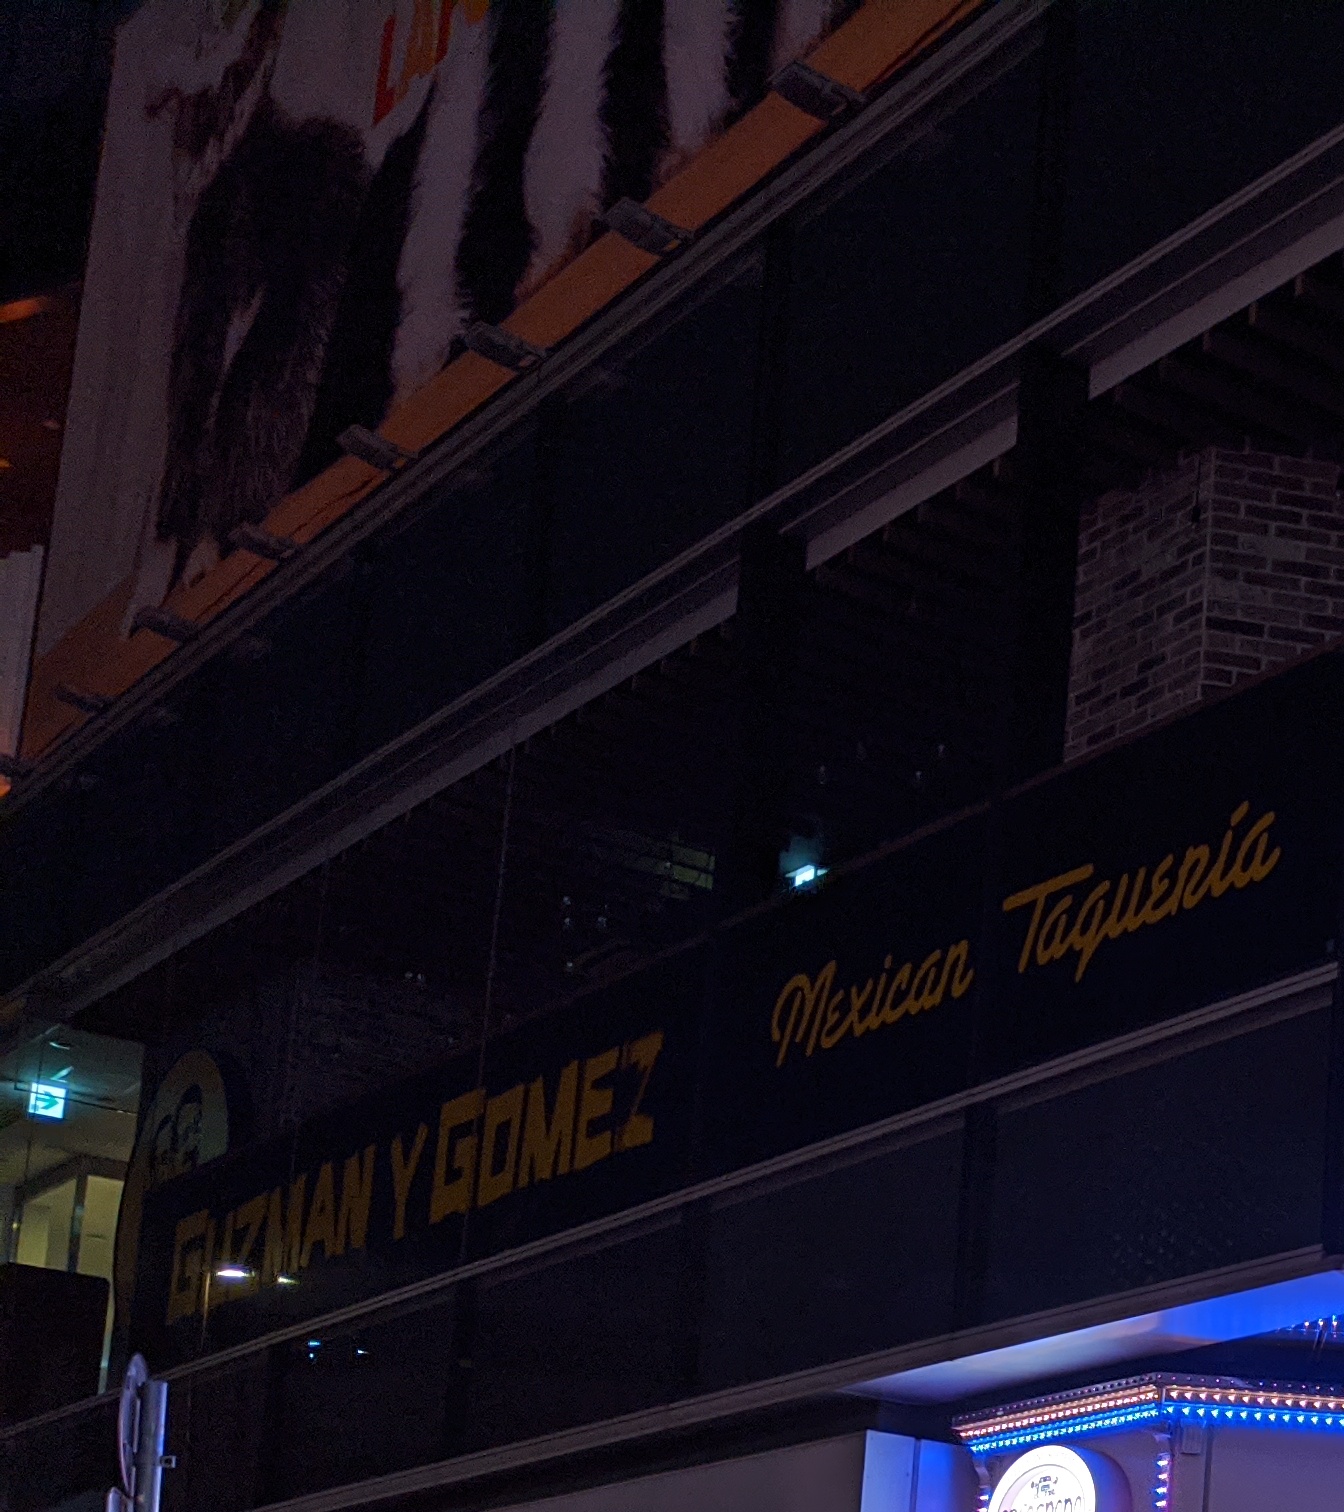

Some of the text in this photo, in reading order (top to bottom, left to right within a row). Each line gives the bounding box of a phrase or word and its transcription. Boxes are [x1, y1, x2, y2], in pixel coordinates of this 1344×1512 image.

[770, 939, 975, 1068] Mexican
[166, 1029, 665, 1325] GUZMAN Y GOMEZ
